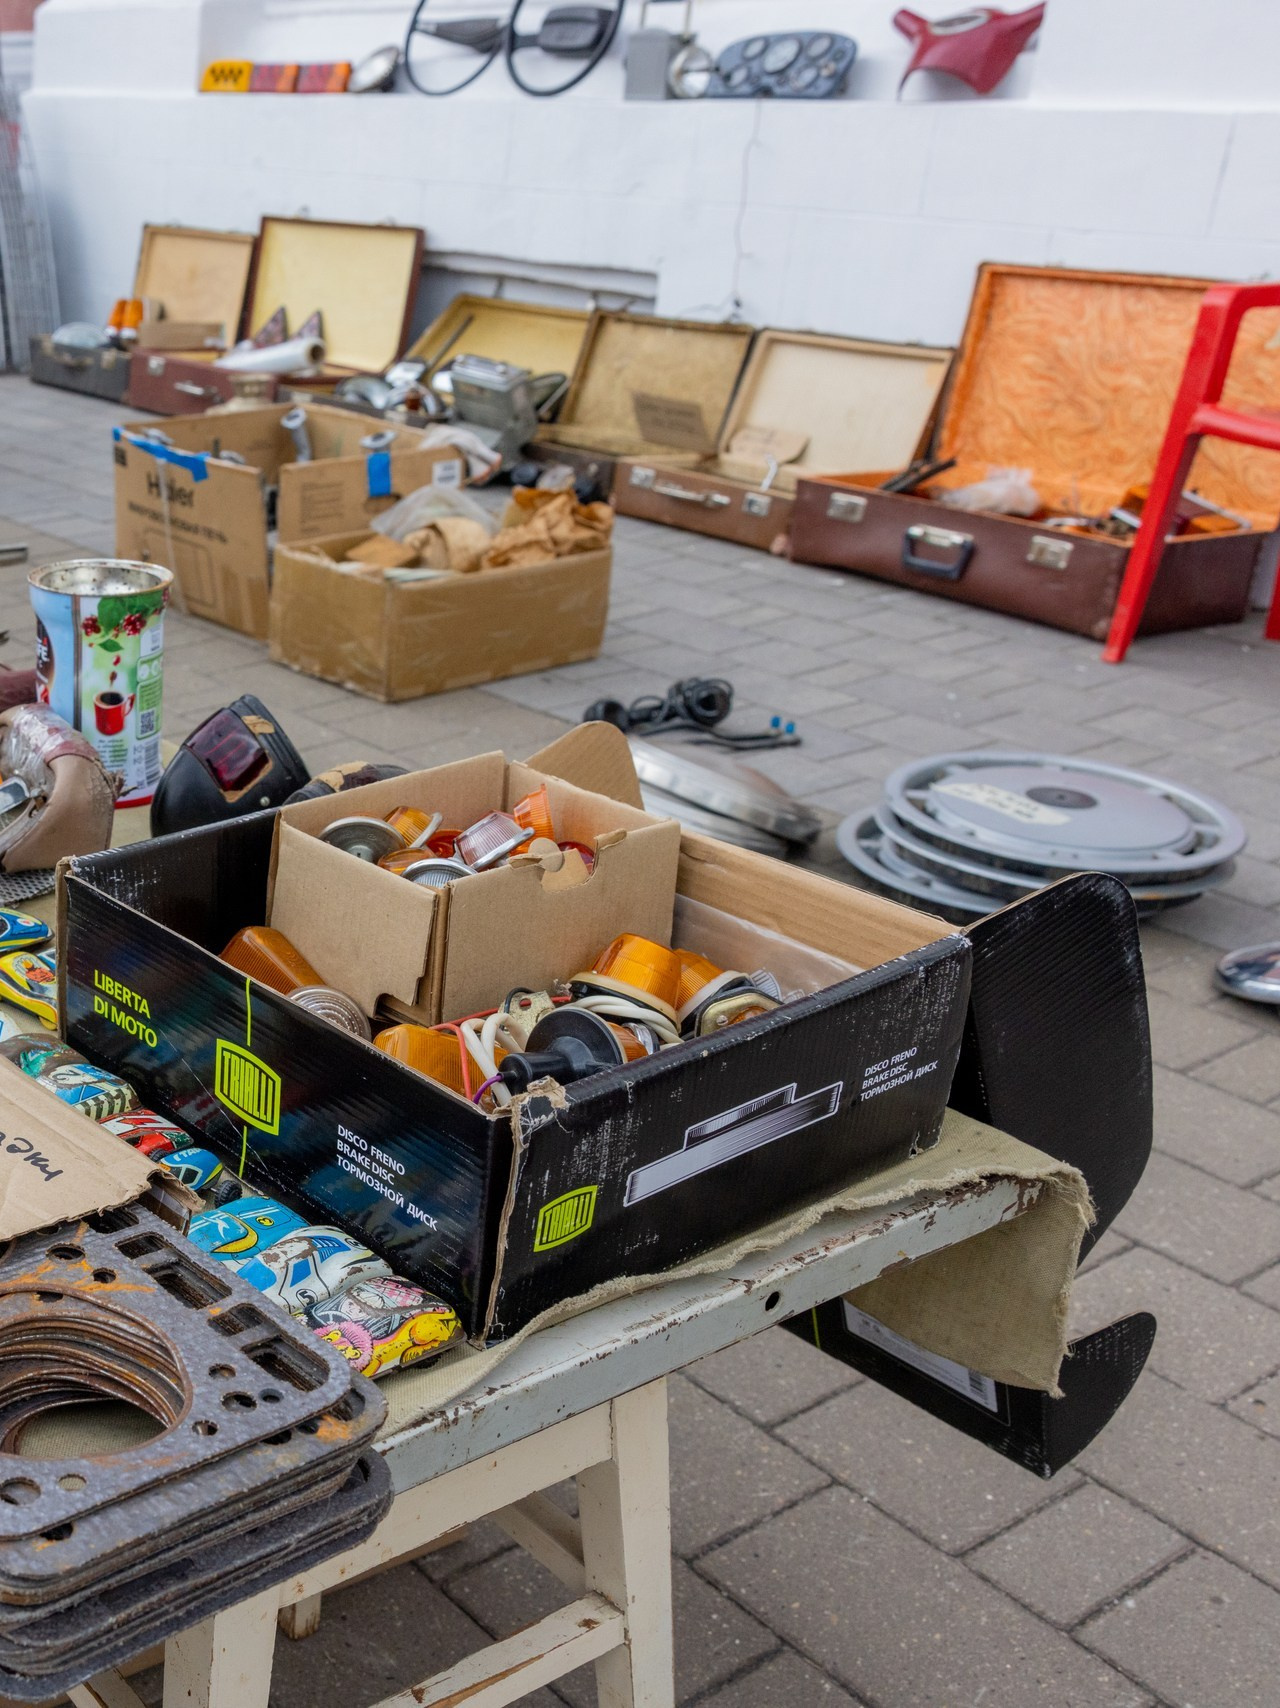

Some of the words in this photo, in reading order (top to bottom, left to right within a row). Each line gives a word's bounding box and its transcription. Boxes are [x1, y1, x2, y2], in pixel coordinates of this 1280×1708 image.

[94, 968, 151, 1019] LIBERTA
[94, 995, 109, 1019] DI
[111, 1005, 158, 1048] MOTO
[222, 1050, 274, 1124] TRIALLI
[860, 1070, 914, 1102] ТОРМОЗНОЙ
[914, 1060, 938, 1080] ДИСК
[862, 1070, 890, 1090] BRAKE
[889, 1062, 908, 1078] DISC
[864, 1060, 889, 1077] DISCO
[890, 1046, 917, 1066] FRENO
[336, 1139, 371, 1170] BRAKE
[371, 1162, 395, 1186] DISC
[337, 1124, 368, 1151] DISCO
[370, 1145, 405, 1176] FRENO
[336, 1154, 404, 1208] ТОРМОЗНОЙ
[406, 1202, 438, 1232] ДИСК
[541, 1193, 591, 1244] TRIALLI
[298, 1290, 316, 1305] 5
